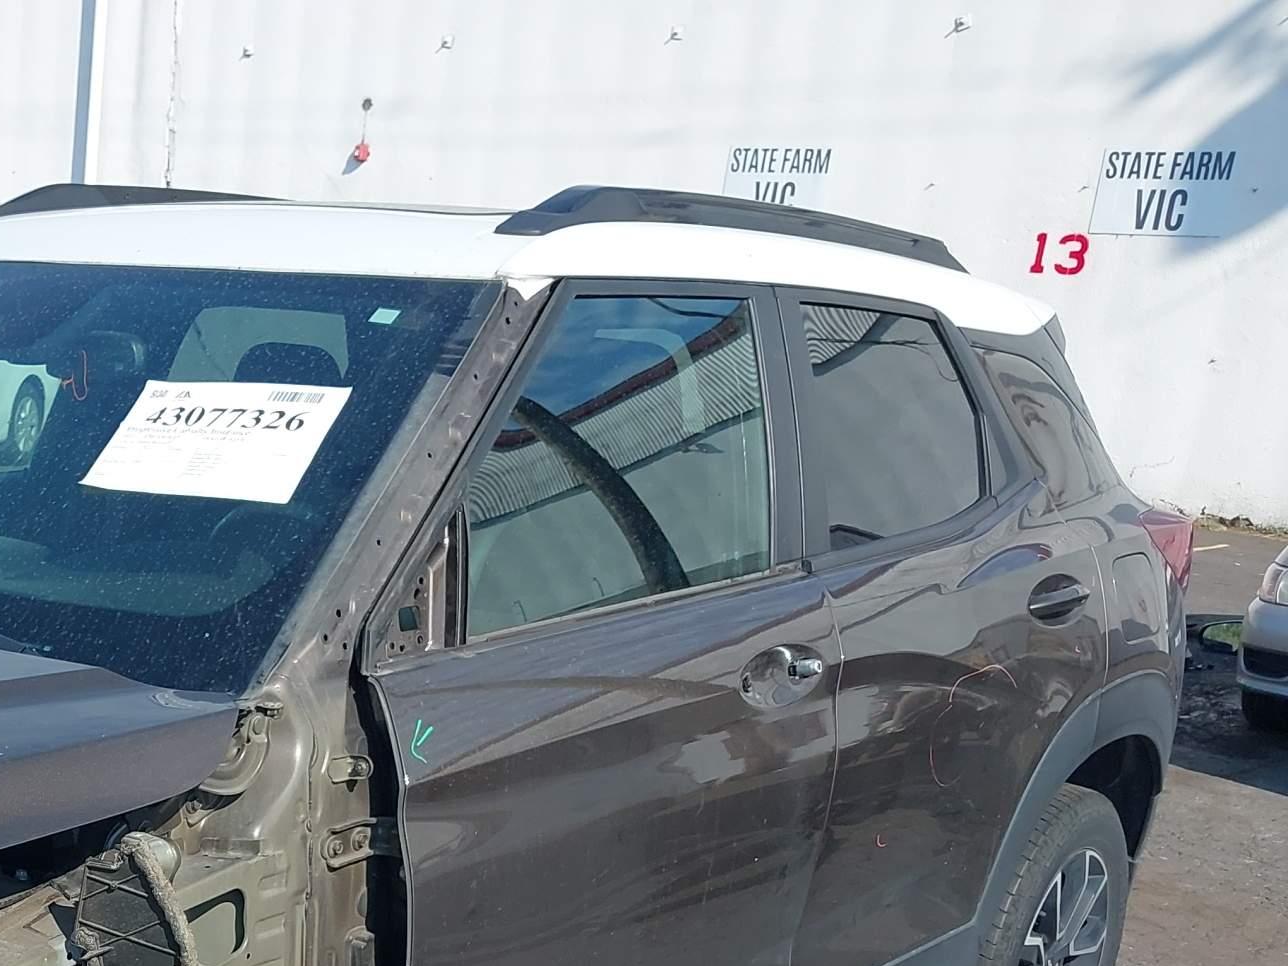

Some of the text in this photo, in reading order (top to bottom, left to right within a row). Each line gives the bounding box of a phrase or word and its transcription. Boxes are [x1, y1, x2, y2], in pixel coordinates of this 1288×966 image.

[731, 148, 832, 174] STATE FARM
[1105, 151, 1237, 180] STATE FARM
[1134, 189, 1189, 232] VIC
[1029, 232, 1090, 276] 13
[145, 405, 311, 431] 43077326
